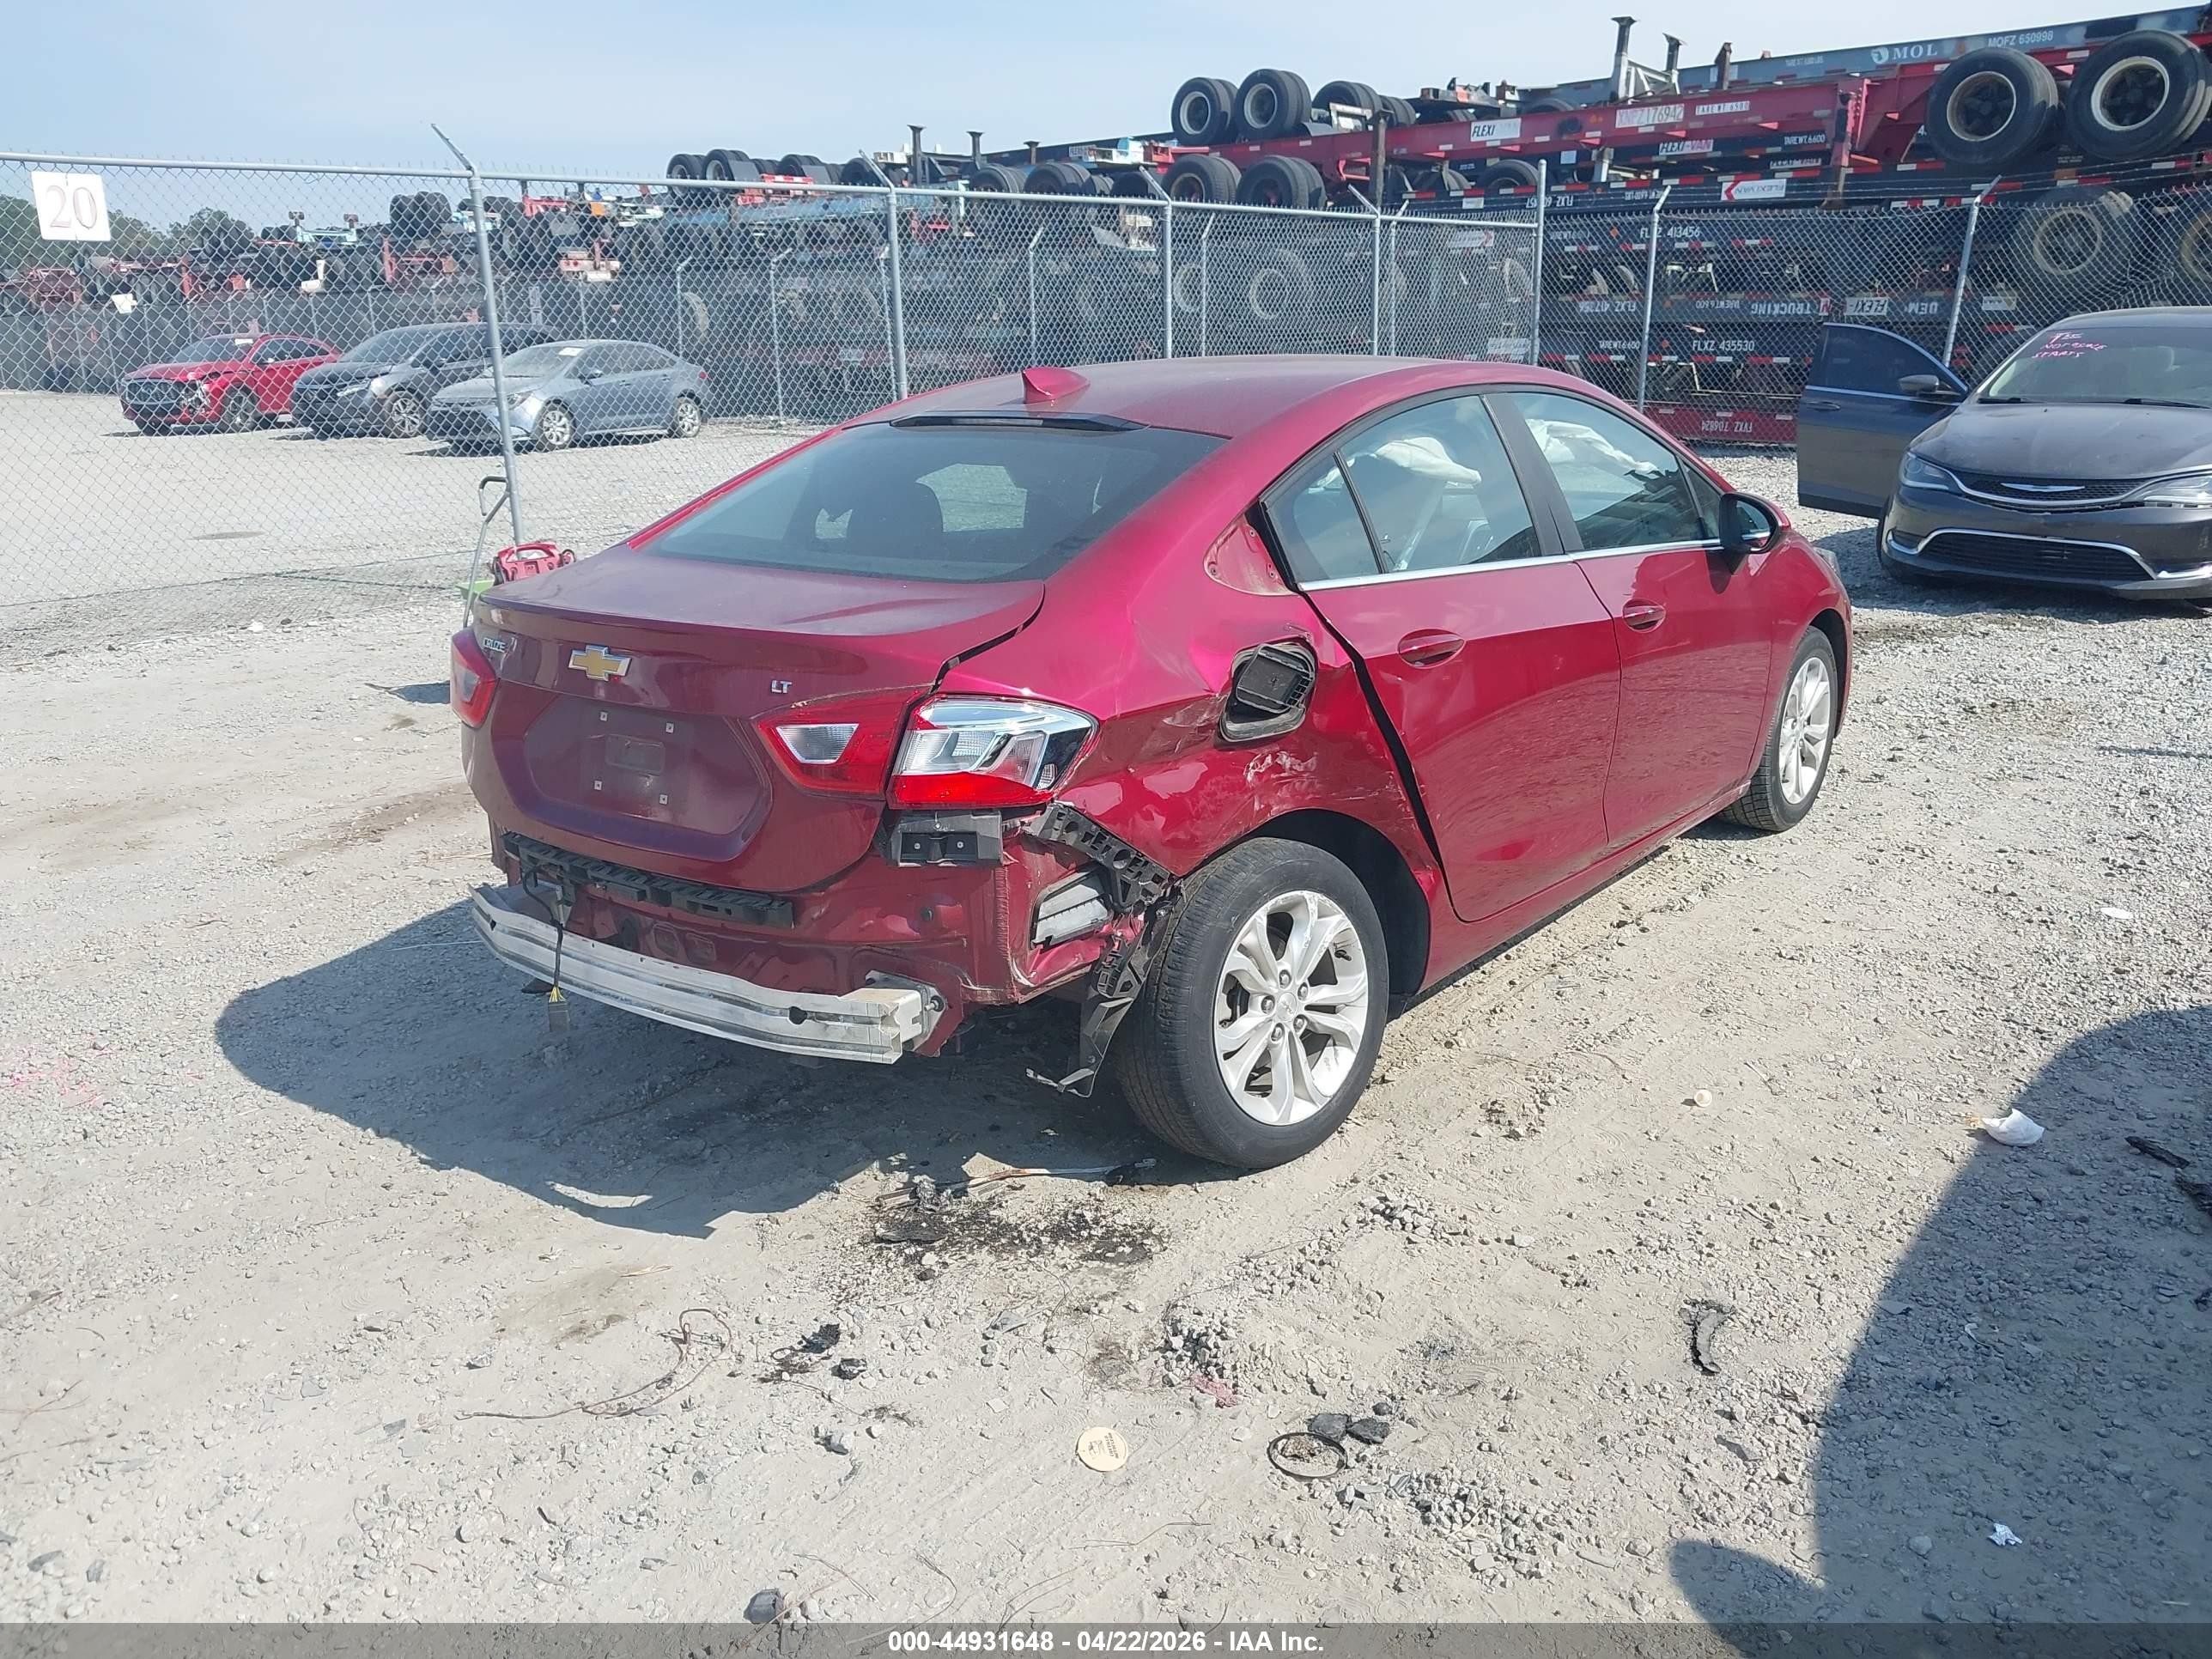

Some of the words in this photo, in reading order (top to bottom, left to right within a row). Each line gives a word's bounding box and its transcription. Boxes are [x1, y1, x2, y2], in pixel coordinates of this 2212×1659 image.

[2019, 30, 2054, 45] 650998
[1893, 44, 1938, 60] MOL
[46, 185, 97, 229] 20
[1640, 228, 1662, 239] FLZ
[1667, 226, 1700, 238] 413456
[1750, 302, 1812, 315] TRUCKING
[1692, 341, 1716, 351] FLXZ
[1719, 340, 1755, 351] 435530
[771, 679, 792, 694] LT
